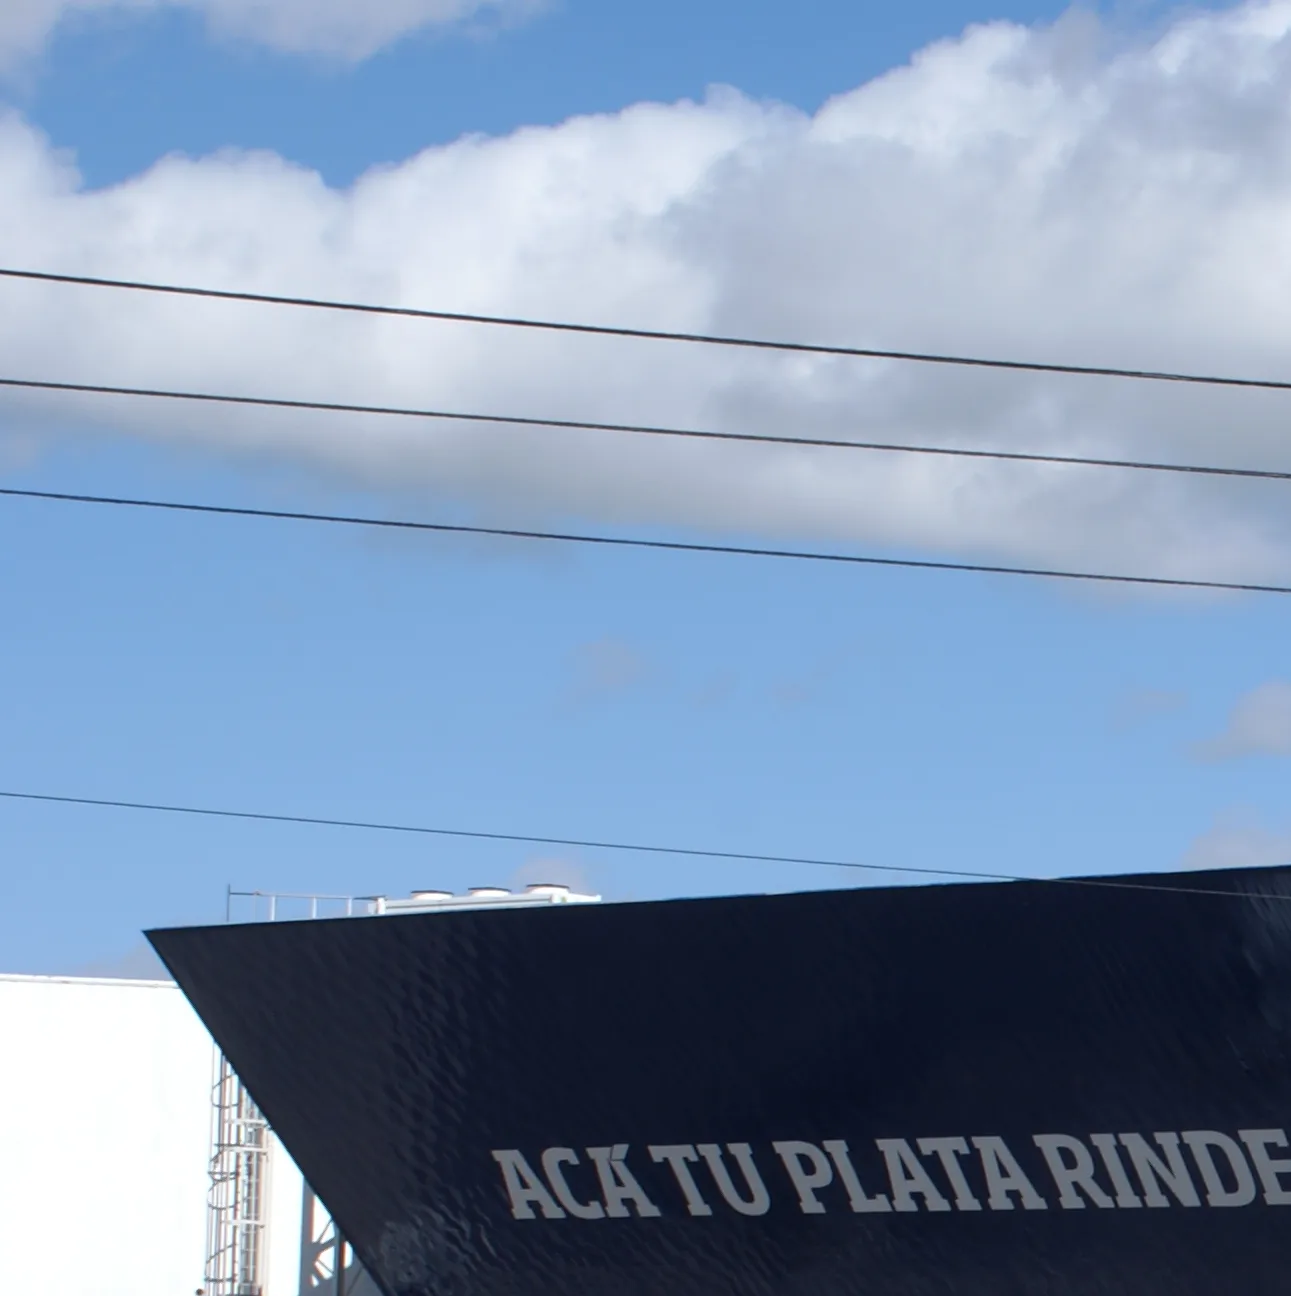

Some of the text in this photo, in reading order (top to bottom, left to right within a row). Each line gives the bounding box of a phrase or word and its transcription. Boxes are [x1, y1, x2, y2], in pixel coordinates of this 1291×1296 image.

[491, 1144, 662, 1220] ACÁ
[648, 1142, 771, 1217] TU
[771, 1134, 1049, 1214] PLATA
